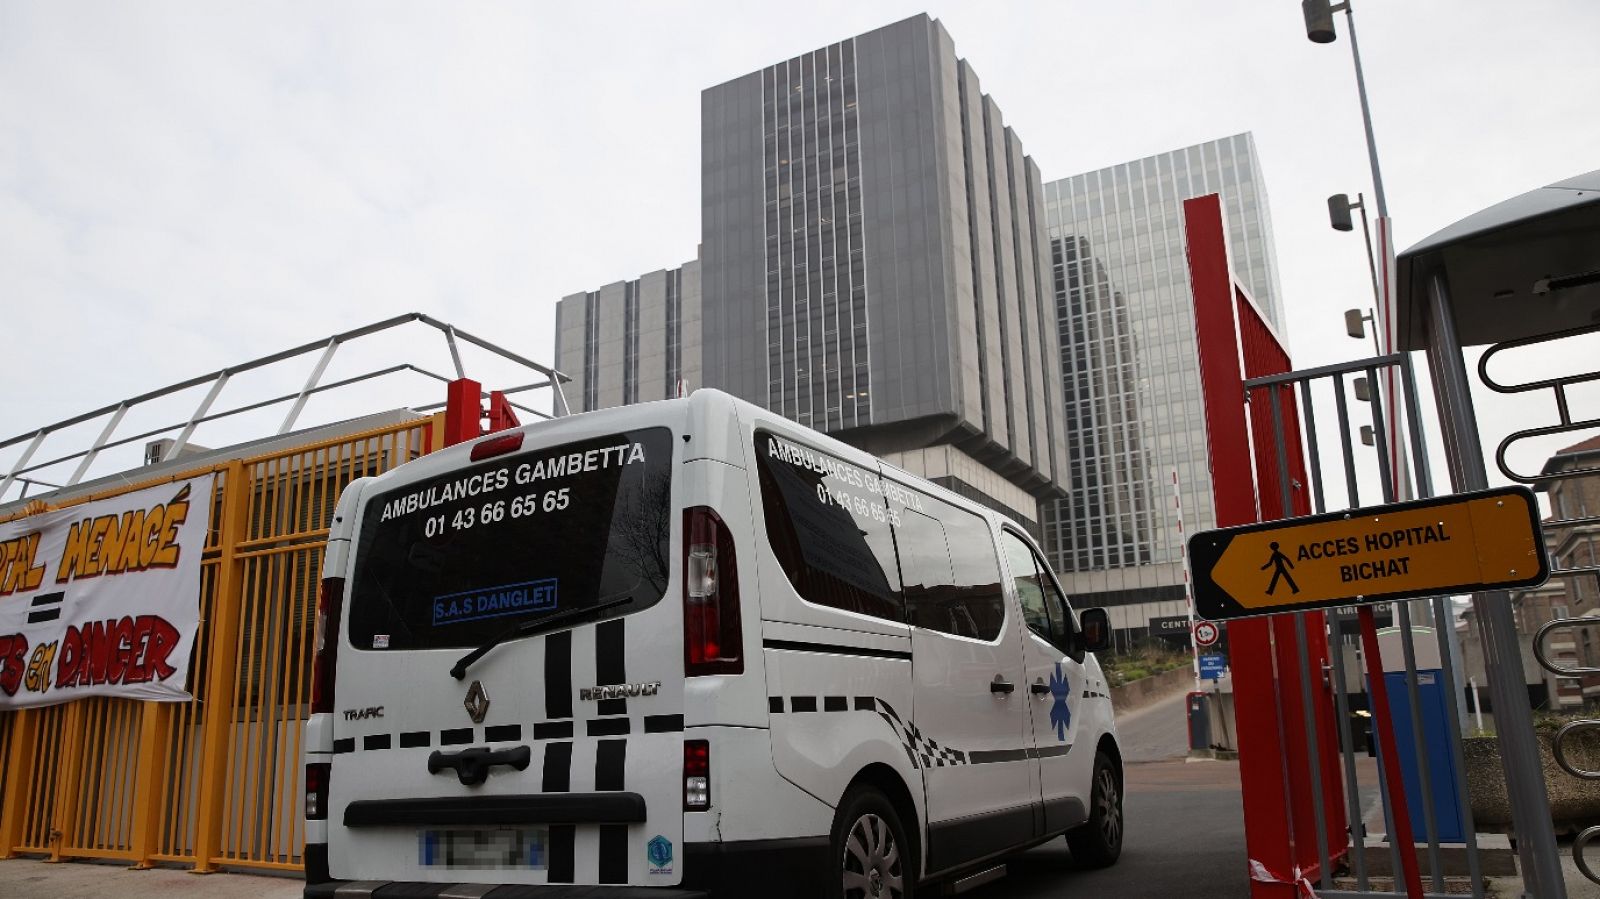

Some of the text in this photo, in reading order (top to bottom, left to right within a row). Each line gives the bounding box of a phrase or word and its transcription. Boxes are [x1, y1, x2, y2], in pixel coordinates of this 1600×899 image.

[380, 442, 646, 523] AMBULANCES GAMBETTA
[768, 437, 924, 512] AMBULANCES GAMBETTA
[425, 487, 570, 538] 01 43 66 65 65
[816, 483, 834, 506] 01
[853, 496, 869, 518] 66
[56, 482, 191, 583] MENACÉ
[1297, 524, 1451, 562] ACCES HOPITAL
[1340, 556, 1411, 583] BICHAT
[434, 586, 554, 619] S.A.S DANGLET
[55, 614, 181, 688] DANGER
[579, 681, 662, 701] RENAULT
[343, 705, 385, 721] TRAFIC
